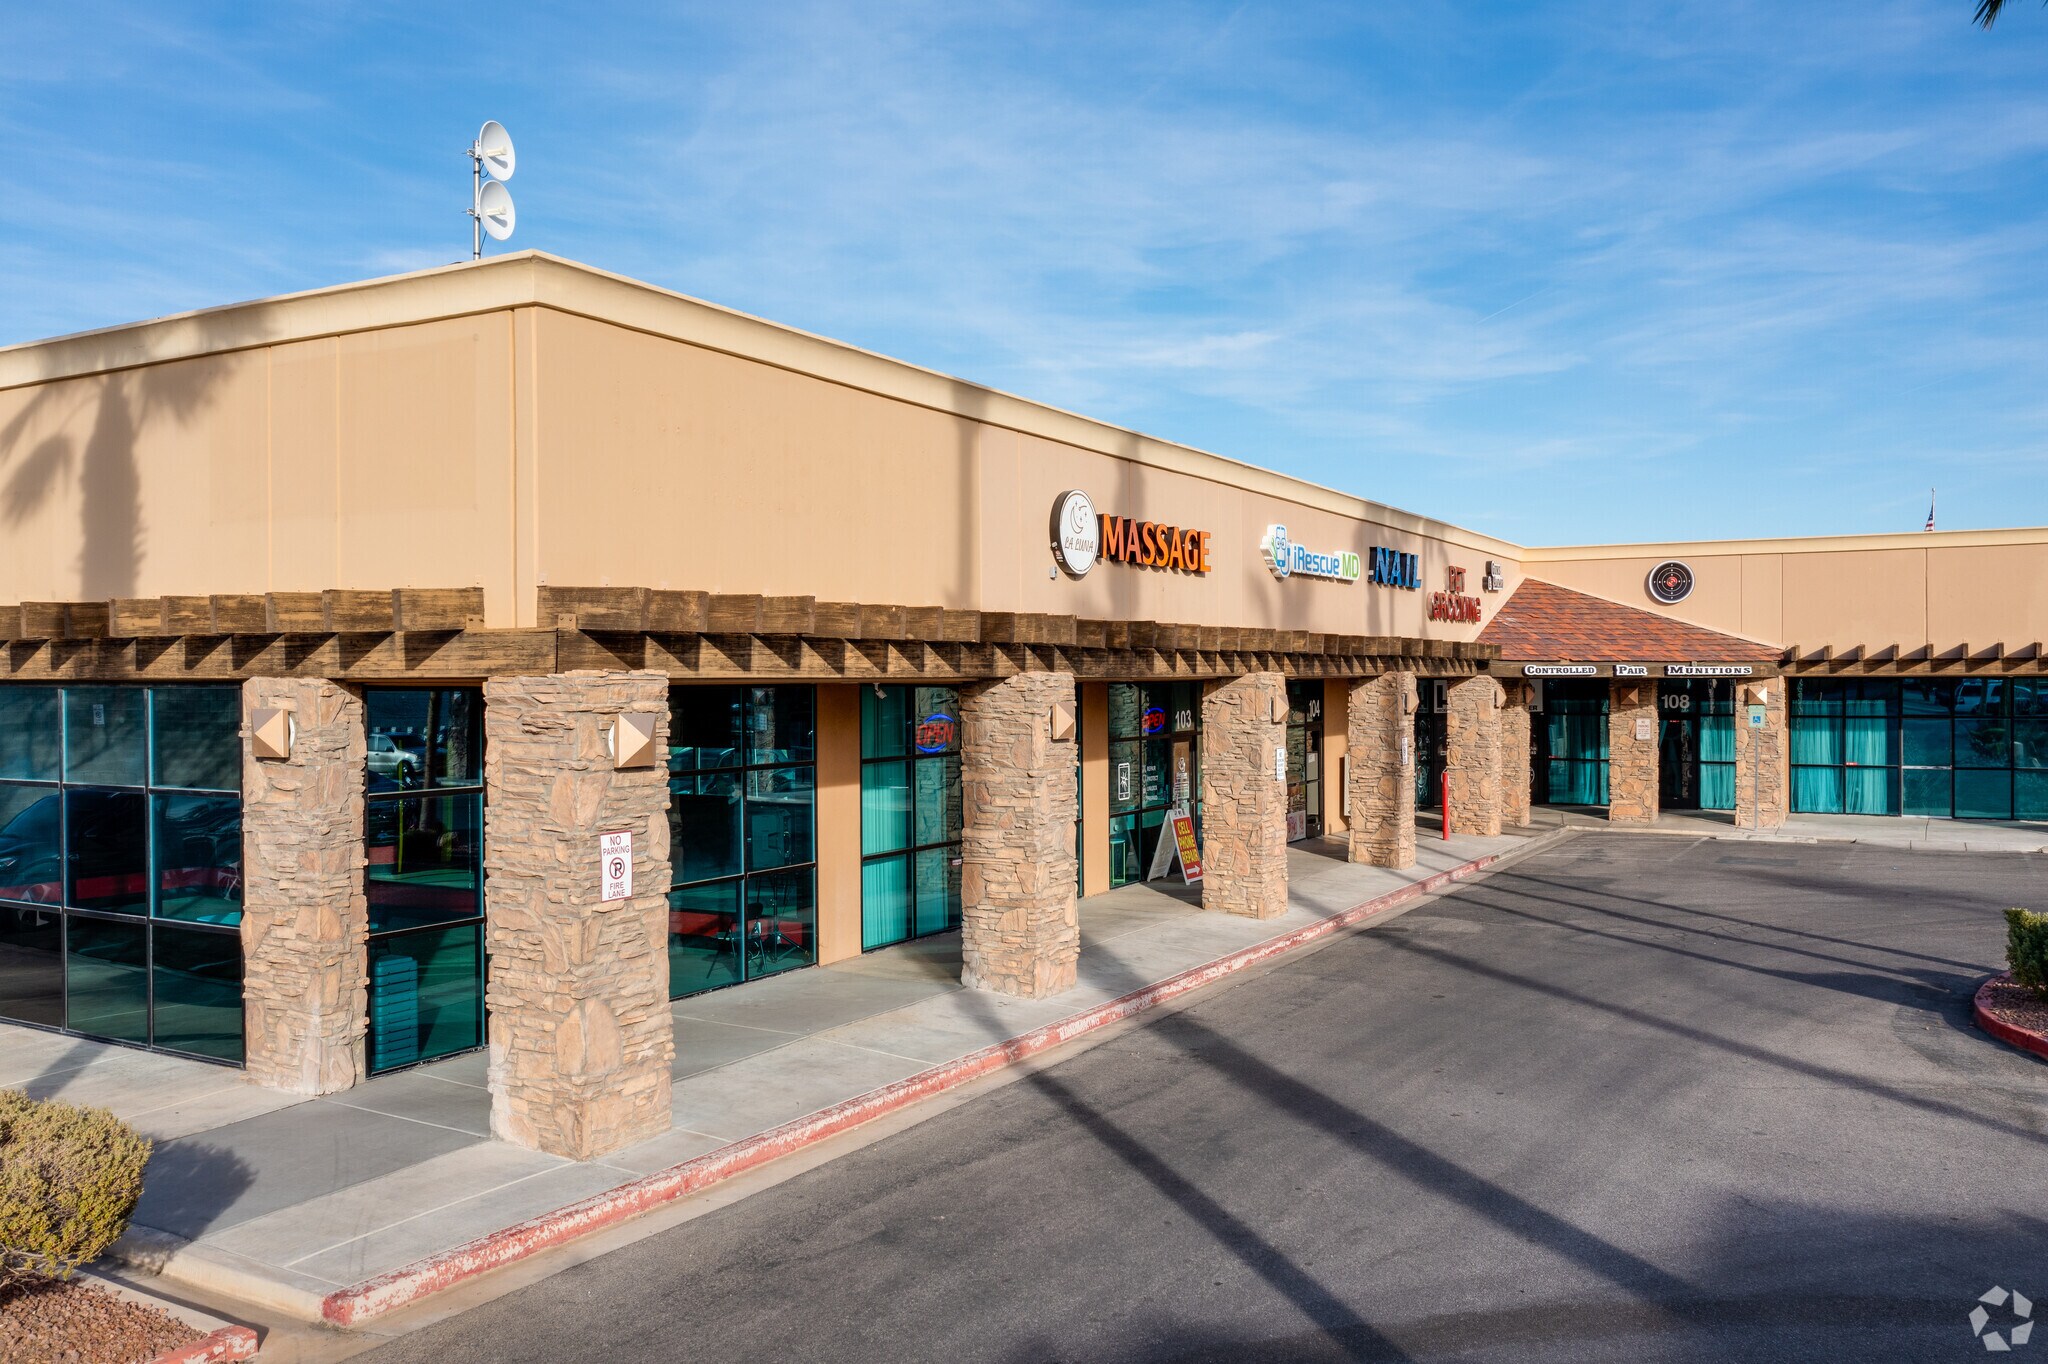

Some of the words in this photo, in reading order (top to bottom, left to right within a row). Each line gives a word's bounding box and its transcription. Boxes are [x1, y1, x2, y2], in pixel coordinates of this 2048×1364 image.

[1102, 513, 1212, 573] MASSAGE
[1374, 546, 1422, 589] NAIL
[1448, 565, 1467, 593] PET
[1431, 591, 1482, 623] GROOMING
[1526, 665, 1596, 675] CONTROLLED
[1618, 665, 1646, 675] PAIR
[1669, 665, 1752, 675] MUNITIONS
[1309, 699, 1321, 717] 104
[1661, 694, 1690, 710] 108
[1142, 713, 1165, 729] OPEN
[1175, 709, 1192, 730] 103
[916, 723, 954, 745] OPEN
[1177, 821, 1191, 835] CELL
[610, 835, 621, 846] NO
[1178, 834, 1196, 849] PHONE
[602, 845, 630, 856] PARKING
[608, 889, 626, 899] LANE
[609, 881, 625, 891] FIRE
